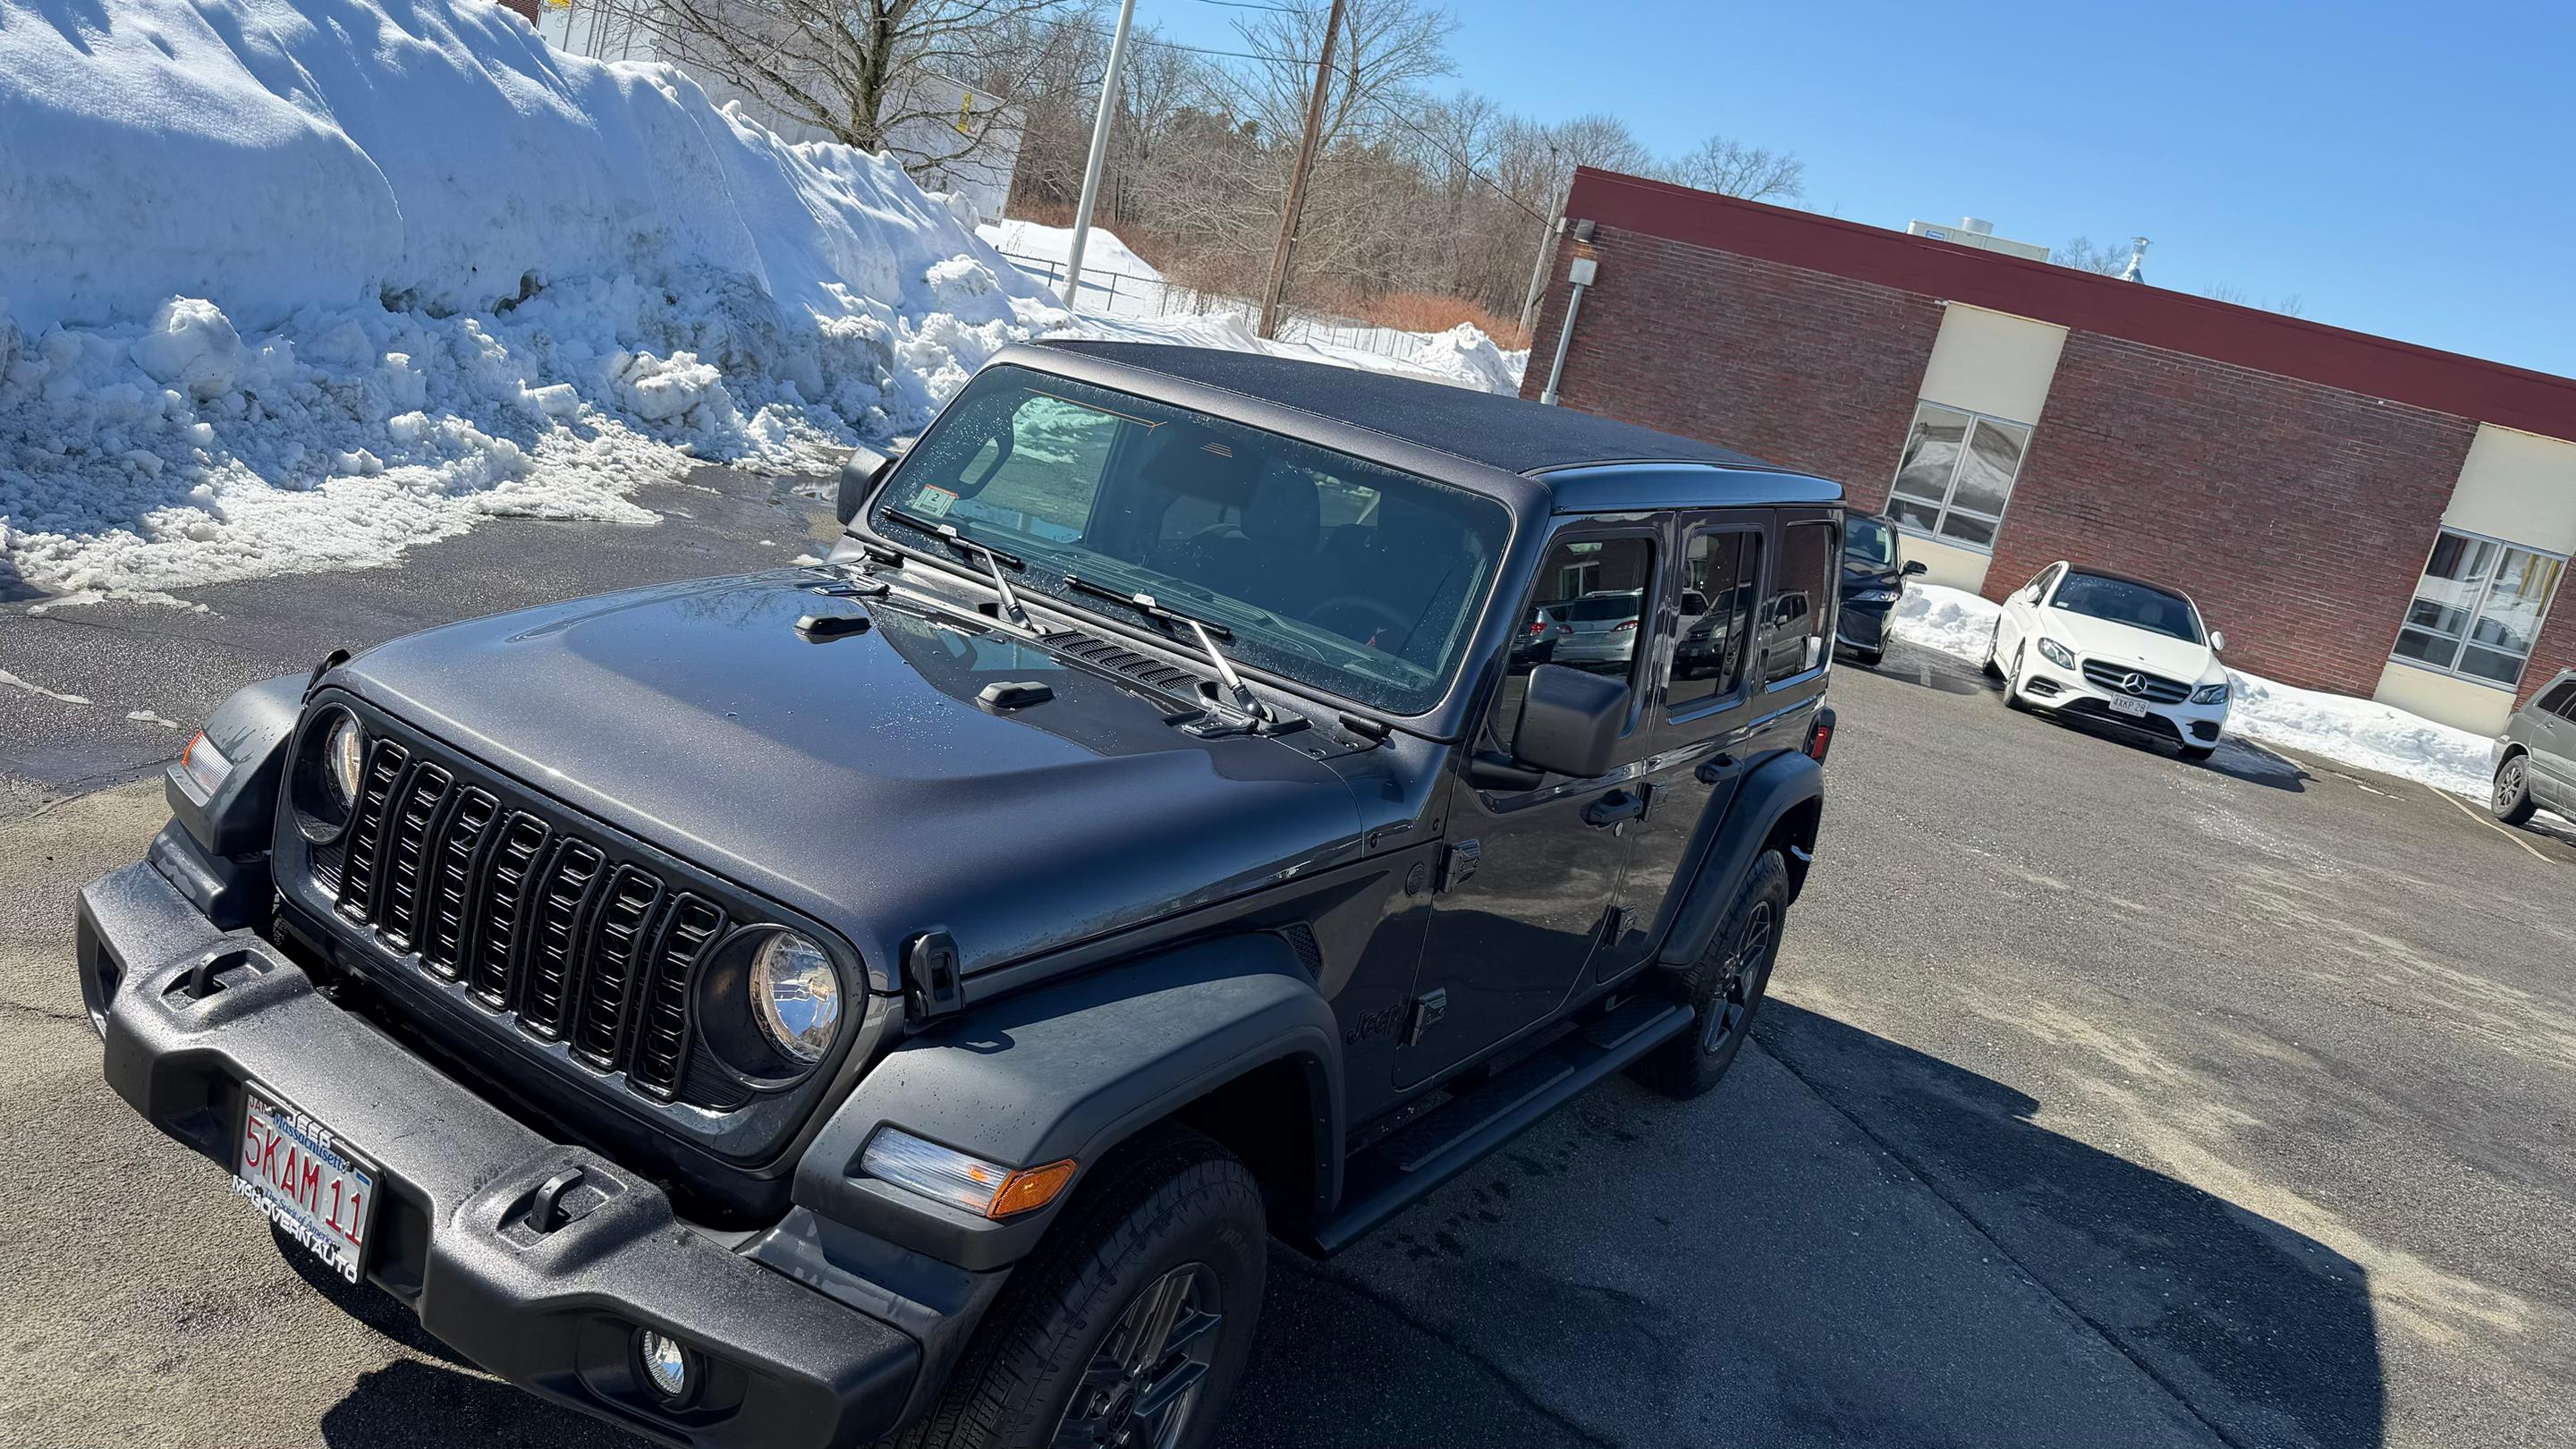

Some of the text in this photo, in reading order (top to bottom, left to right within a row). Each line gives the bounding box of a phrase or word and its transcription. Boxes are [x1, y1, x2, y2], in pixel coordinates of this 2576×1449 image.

[931, 493, 940, 502] 2
[1346, 1004, 1402, 1046] Jeep
[286, 1111, 335, 1149] JEEP
[244, 1114, 361, 1247] 5KAM 11
[311, 1235, 358, 1284] AUTO
